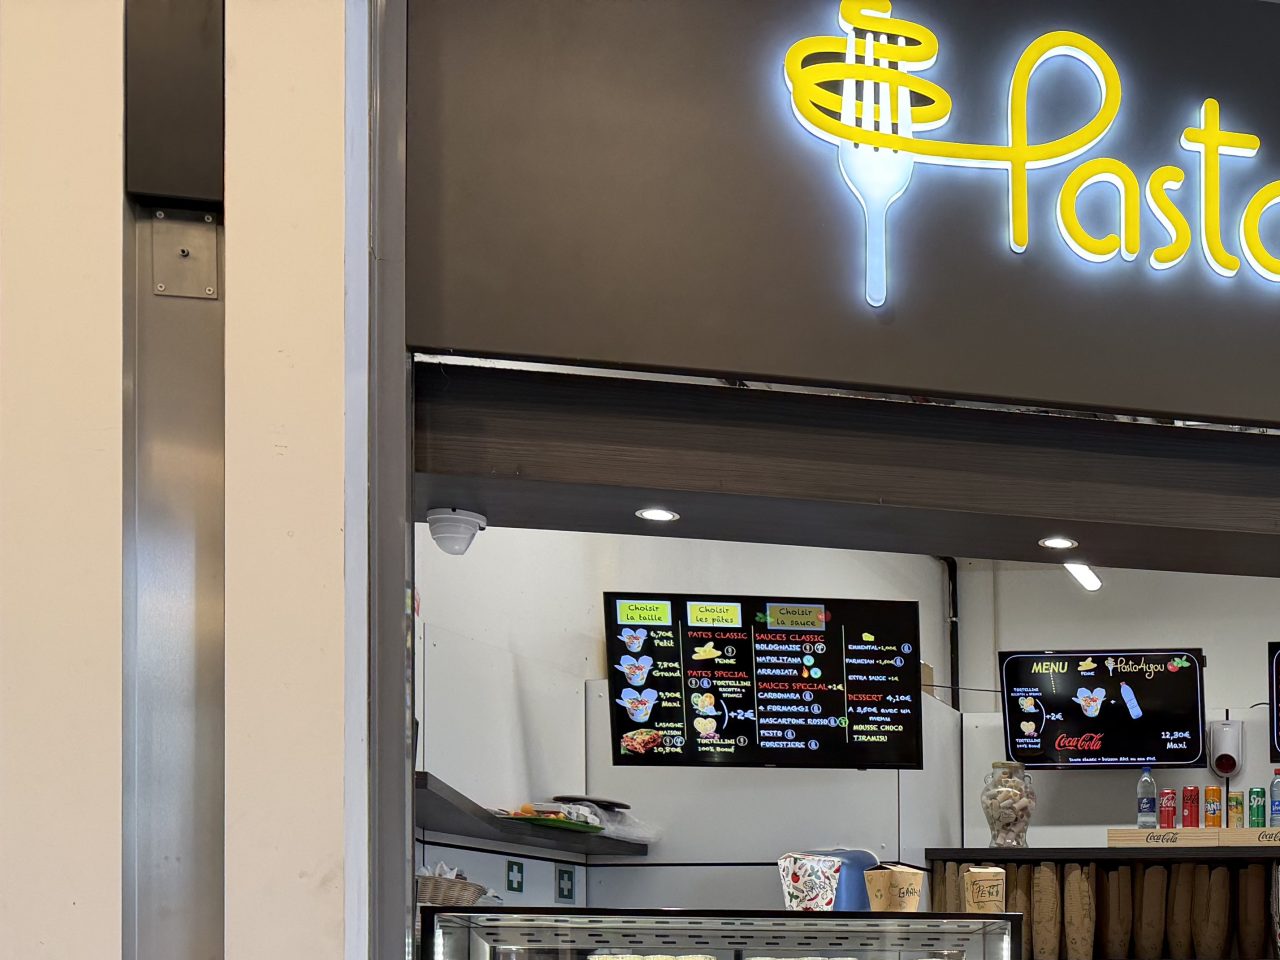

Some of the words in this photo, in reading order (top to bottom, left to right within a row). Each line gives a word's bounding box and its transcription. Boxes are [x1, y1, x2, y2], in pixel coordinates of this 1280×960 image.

[628, 604, 660, 612] Choisir
[698, 606, 730, 614] Choisir
[779, 608, 813, 616] Choisir
[638, 614, 663, 622] taille
[695, 615, 709, 623] les
[711, 616, 734, 626] pâtes
[650, 630, 674, 639] 6,70€
[687, 631, 713, 639] PATES
[755, 633, 787, 641] SAUCES
[790, 634, 825, 642] CLASSIC
[755, 643, 801, 651] BOLOGNAISE
[756, 656, 802, 664] NAPOLITANA
[656, 661, 680, 669] 7,80€
[1031, 662, 1068, 674] MENU
[1114, 657, 1165, 679] Pasta4you
[687, 670, 712, 678] PATES
[758, 682, 789, 690] SAUCES
[659, 692, 682, 700] 9,90€
[886, 695, 912, 703] 4,10€
[728, 709, 756, 720] +2€
[1045, 712, 1064, 721] +2€
[1055, 733, 1104, 751] Coca-Cola
[1167, 742, 1187, 750] Maxi
[653, 746, 683, 754] 10,80€
[1146, 832, 1180, 843] Coca-Cola
